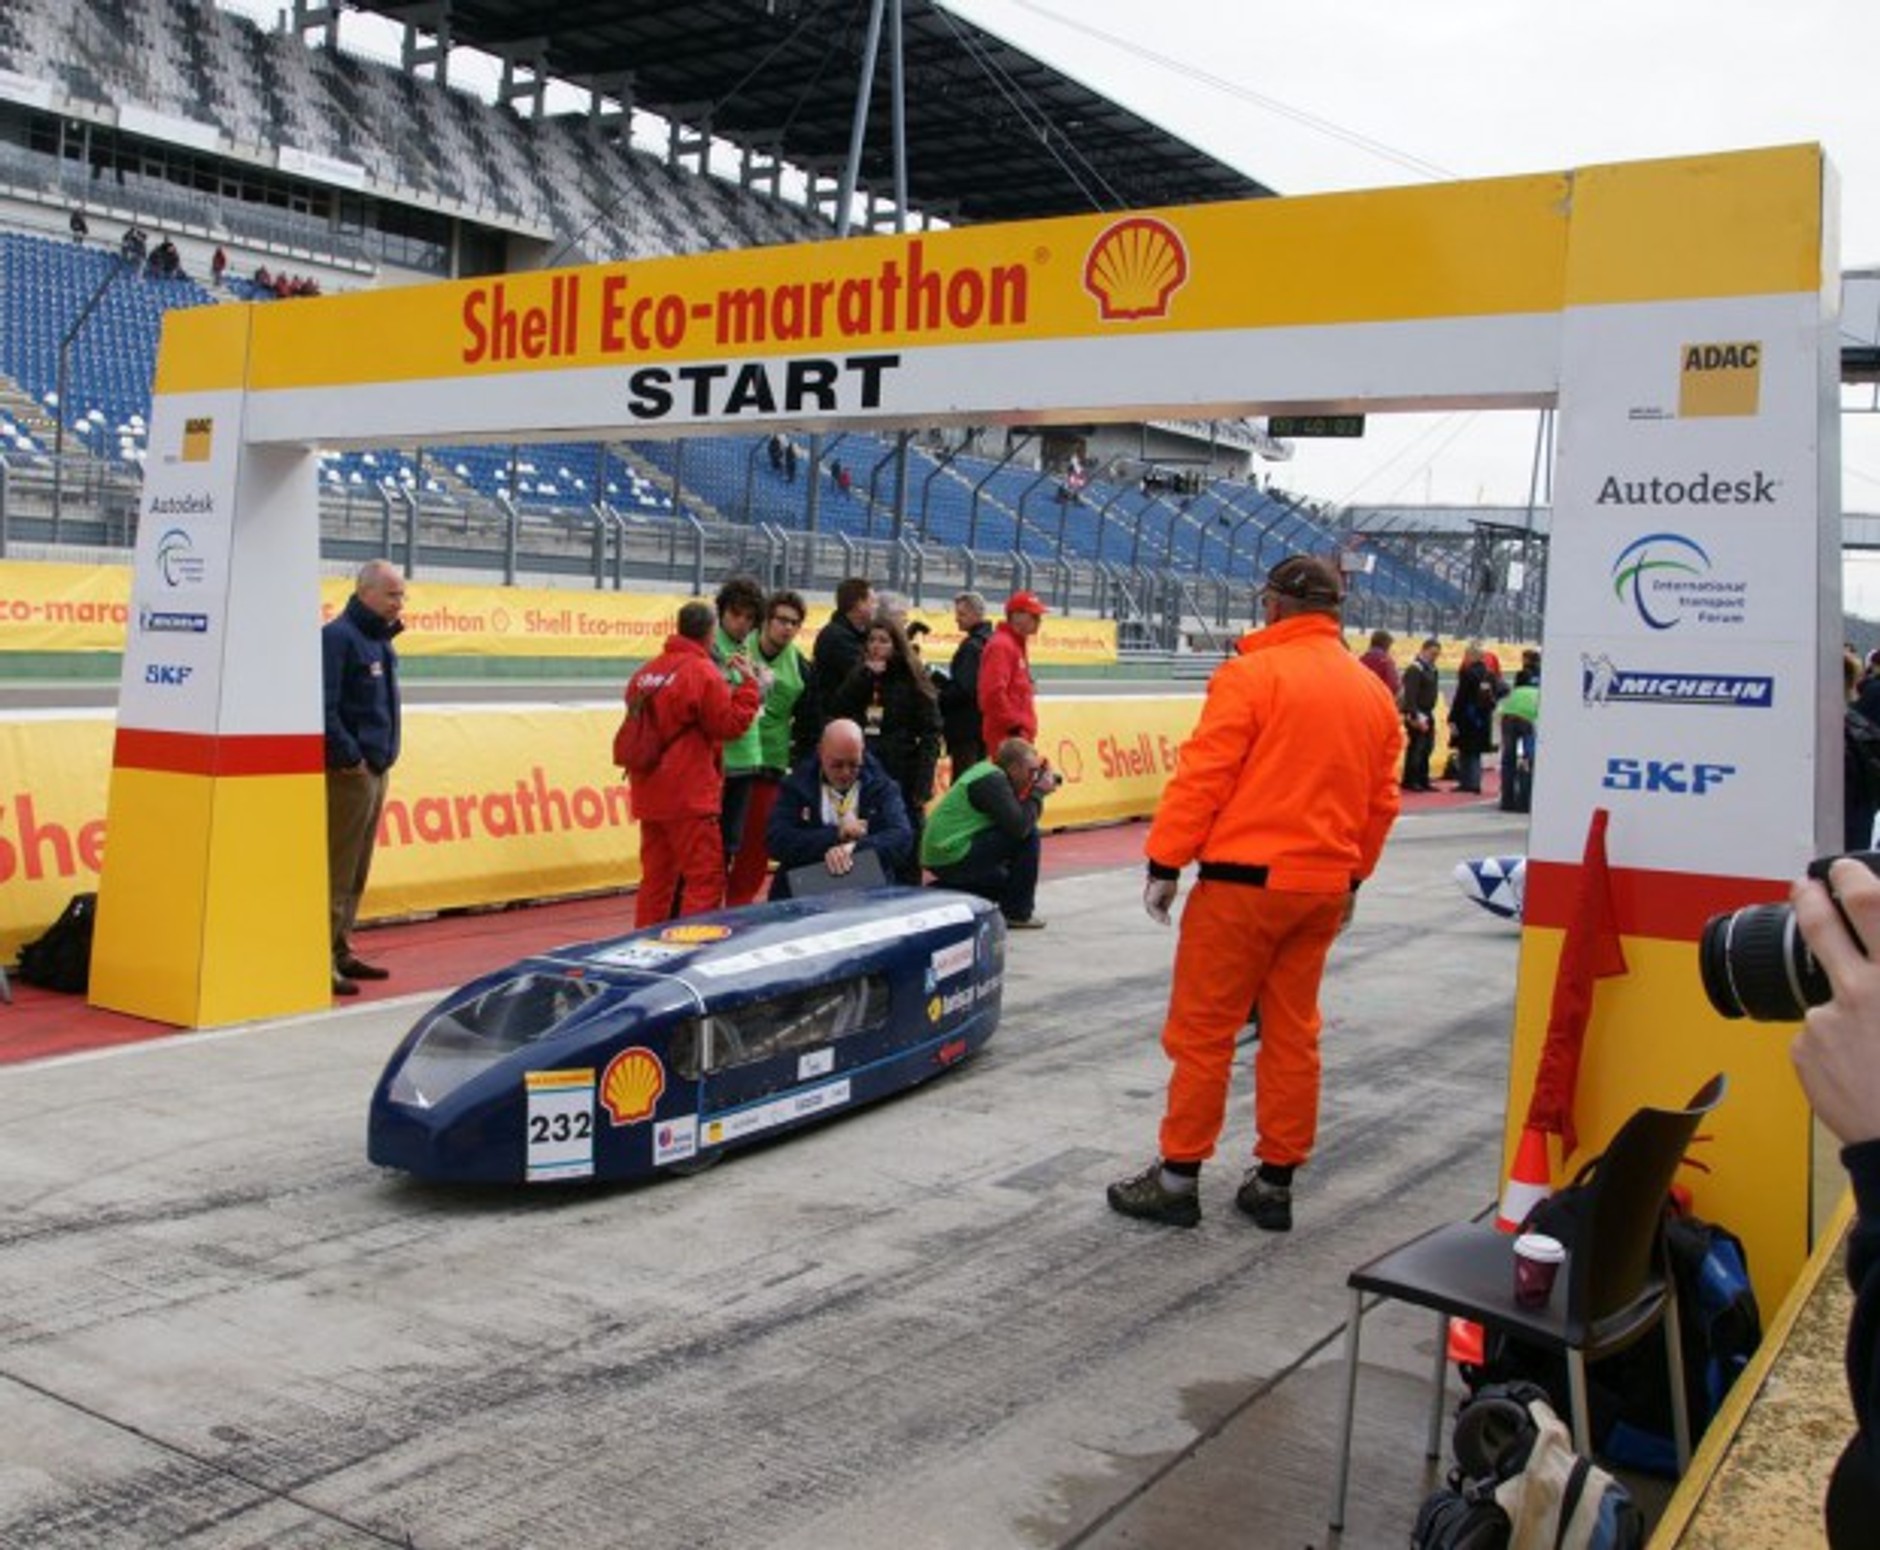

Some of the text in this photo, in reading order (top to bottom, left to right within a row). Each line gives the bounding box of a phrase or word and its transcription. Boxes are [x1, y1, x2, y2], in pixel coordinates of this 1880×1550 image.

[463, 239, 1027, 364] Shell Eco-marathon
[1685, 345, 1758, 371] ADAC
[628, 355, 899, 419] START
[1596, 471, 1777, 504] Autodesk
[150, 494, 213, 513] Autodesk
[1653, 579, 1747, 592] International
[524, 610, 572, 633] Shell
[1698, 611, 1744, 623] Forum
[145, 663, 193, 684] SKF
[1619, 678, 1767, 699] MICHELIN
[1097, 732, 1156, 781] Shell
[1602, 758, 1737, 794] SKF
[529, 1111, 593, 1145] 232
